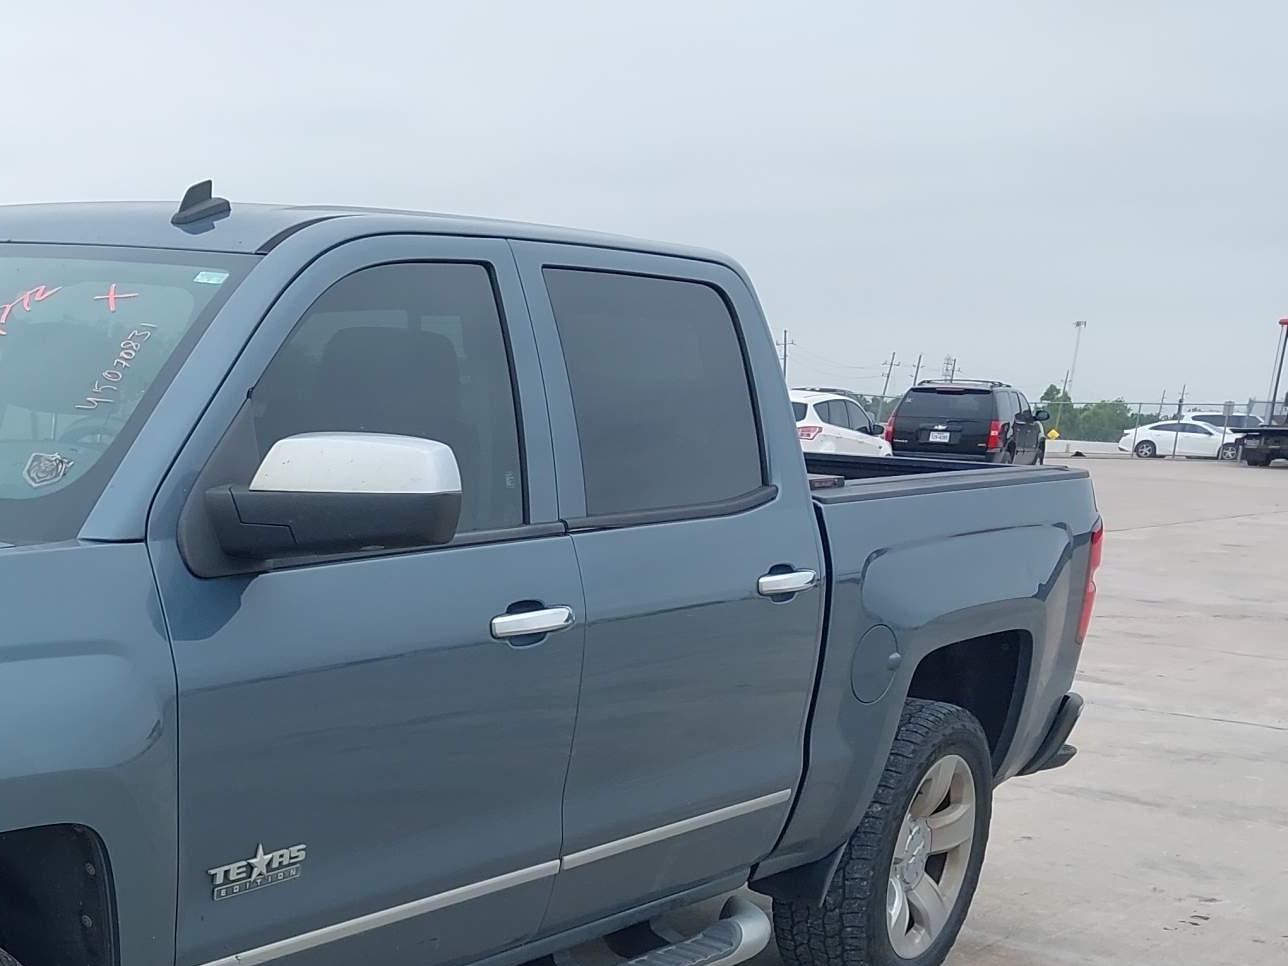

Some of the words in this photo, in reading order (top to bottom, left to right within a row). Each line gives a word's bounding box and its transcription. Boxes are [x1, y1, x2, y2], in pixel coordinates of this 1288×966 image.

[74, 322, 158, 409] 45070831
[207, 843, 307, 885] TEXAS
[220, 867, 297, 896] EDITION
